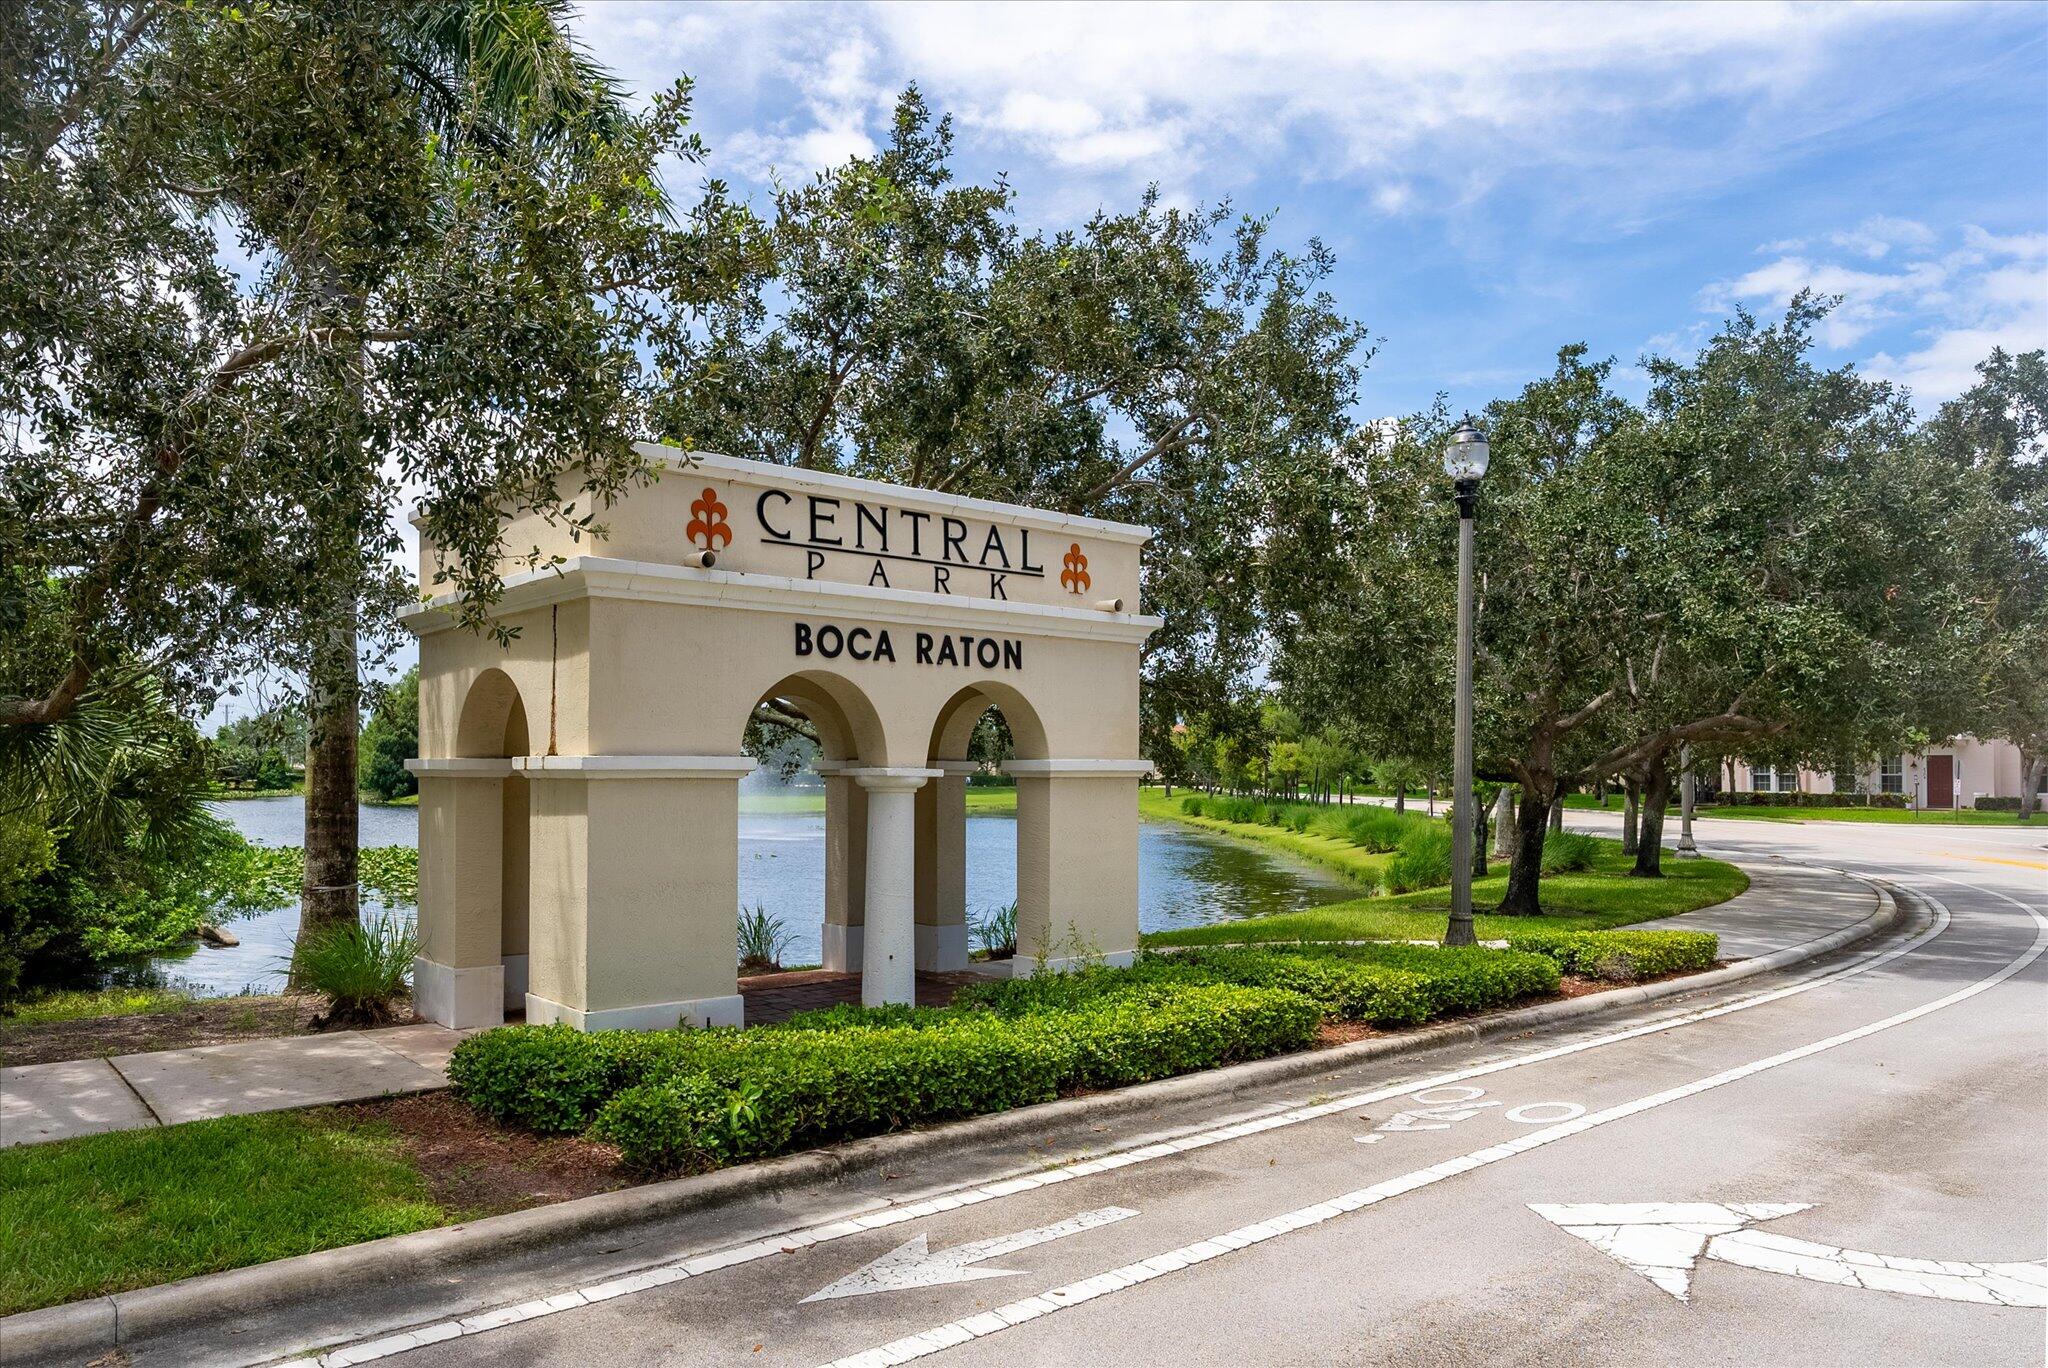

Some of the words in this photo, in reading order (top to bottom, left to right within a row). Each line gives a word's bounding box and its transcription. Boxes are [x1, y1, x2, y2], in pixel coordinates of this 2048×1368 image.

[756, 488, 1045, 574] CENTRAL
[806, 550, 1008, 601] PARK
[794, 622, 897, 663] BOCA
[916, 632, 1023, 671] RATON
